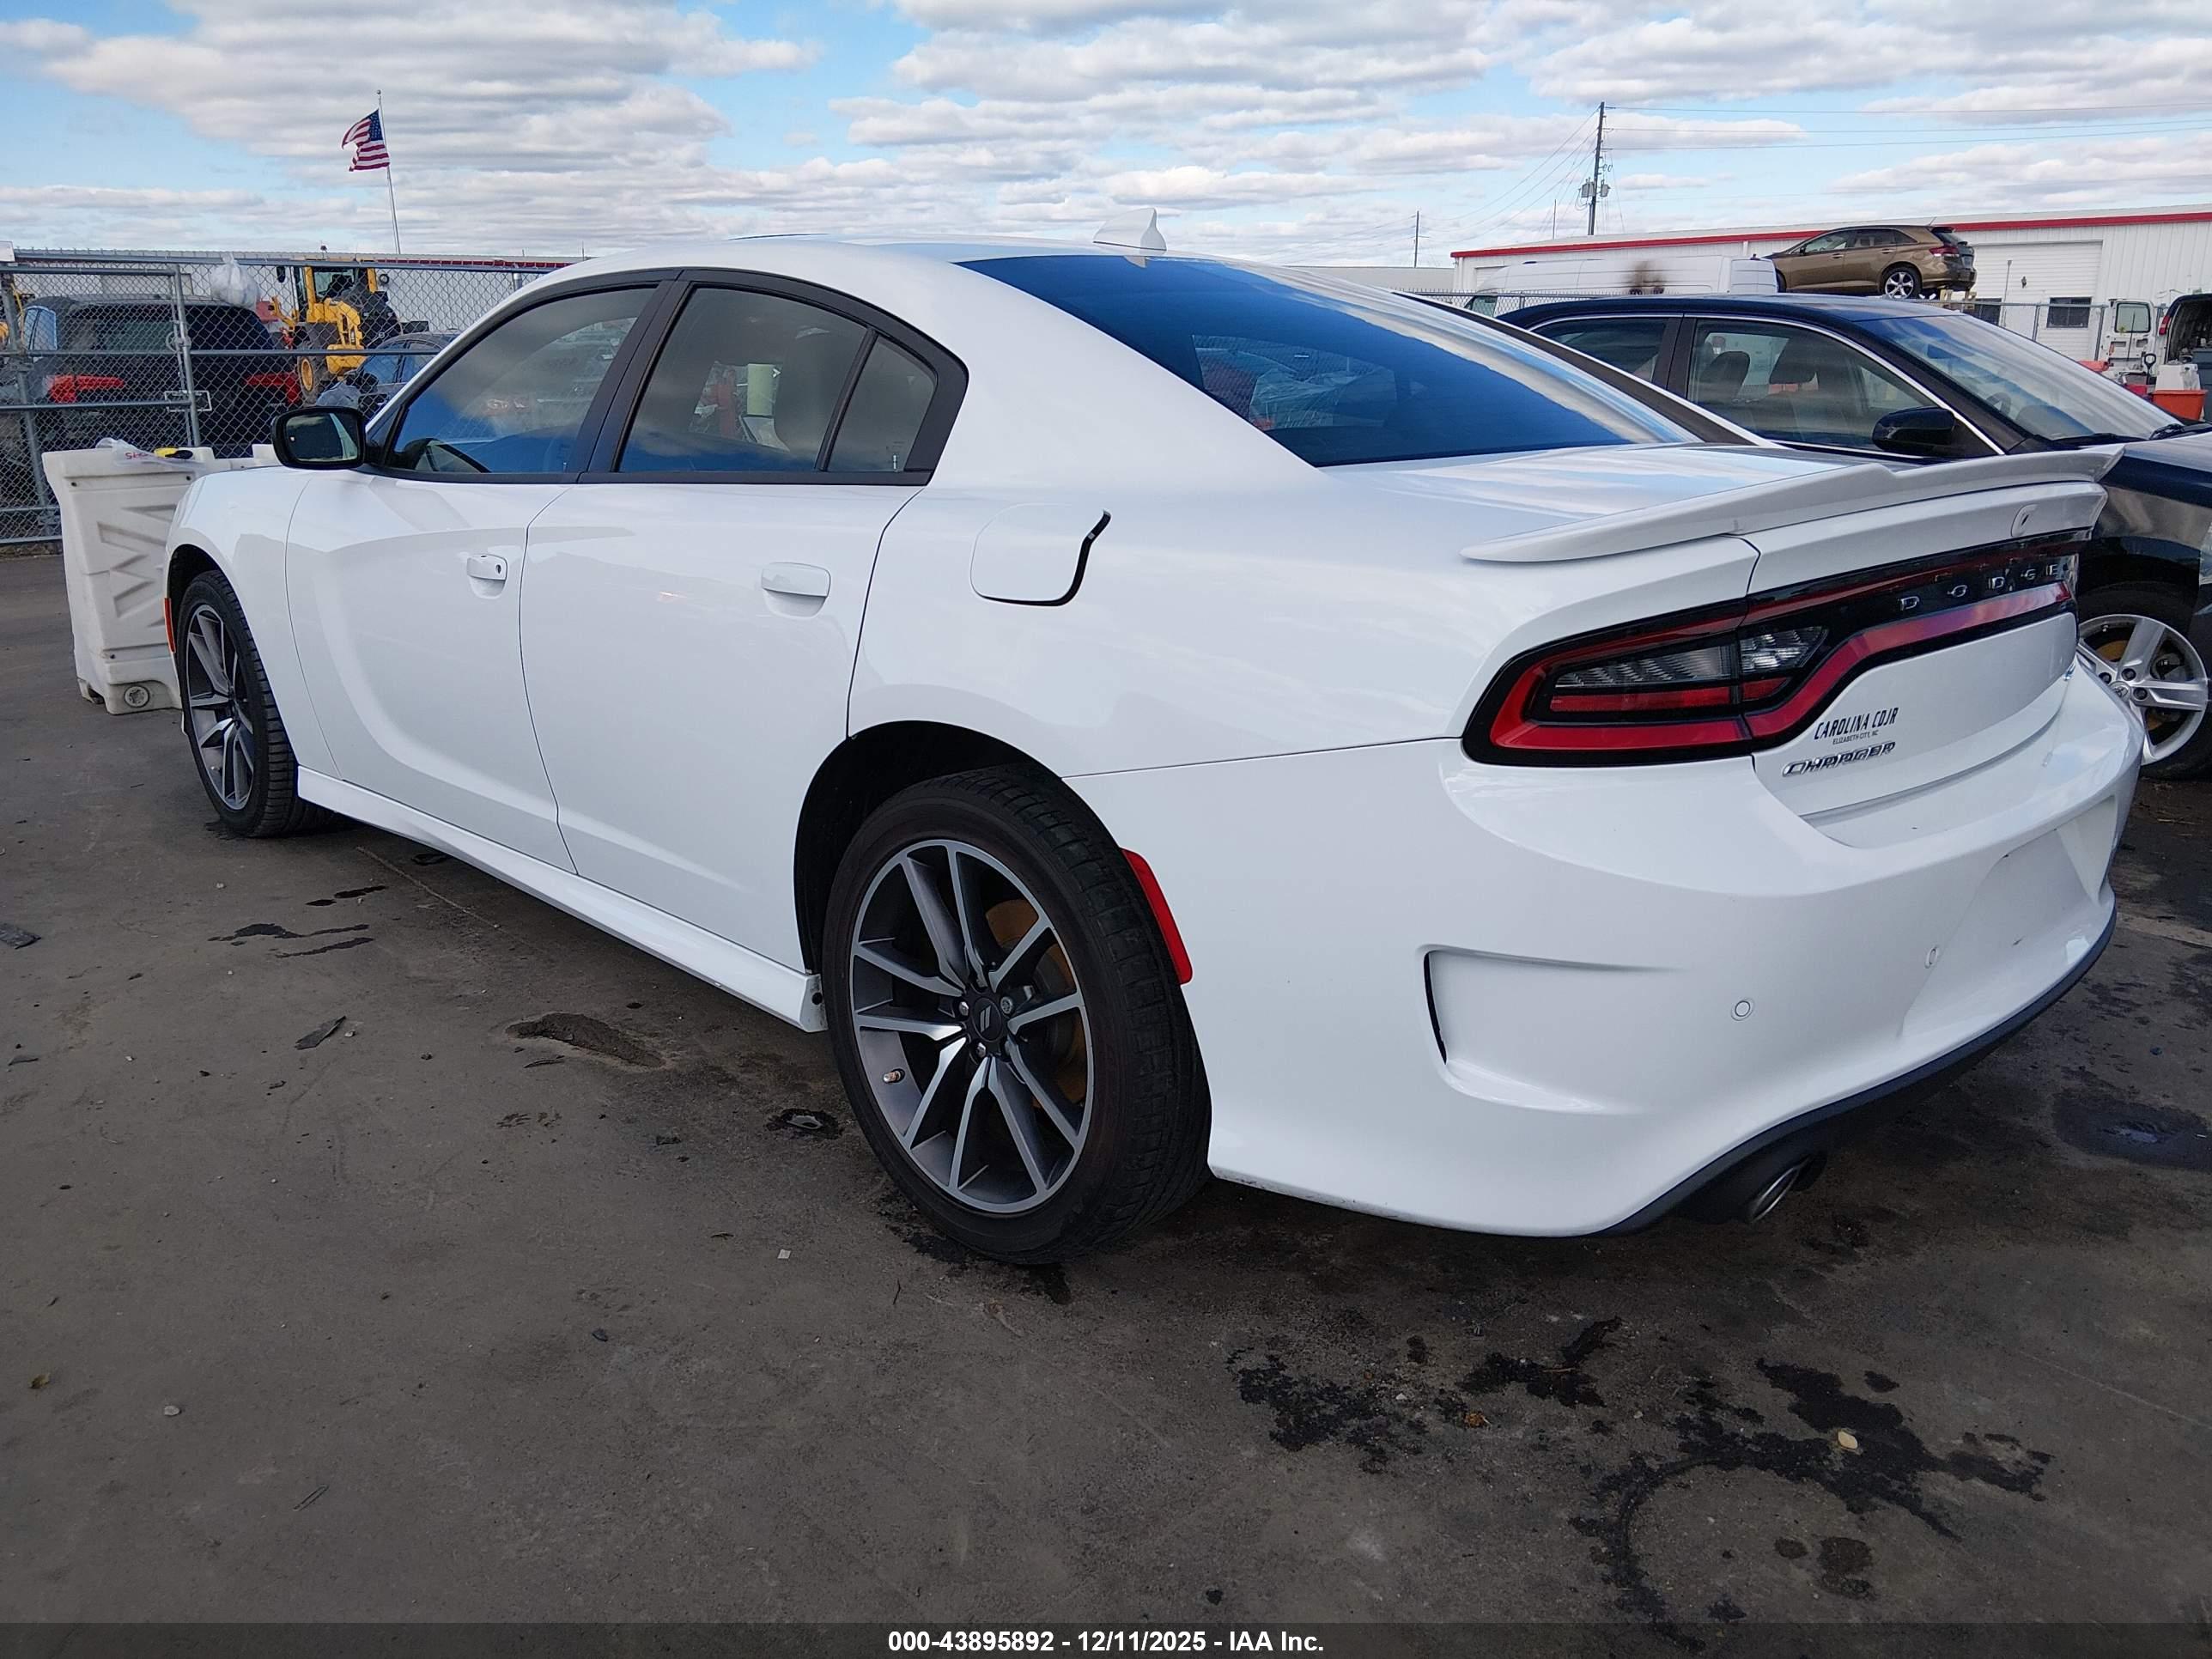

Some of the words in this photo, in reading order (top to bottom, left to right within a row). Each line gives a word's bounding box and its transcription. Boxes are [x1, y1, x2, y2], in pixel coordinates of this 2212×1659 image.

[1899, 563, 2059, 611] DODGE
[1814, 713, 1871, 740] CAROLINA
[1871, 707, 1899, 728] CDJR
[1832, 733, 1860, 745] ELIZABETH
[1782, 741, 1896, 778] CHARGER
